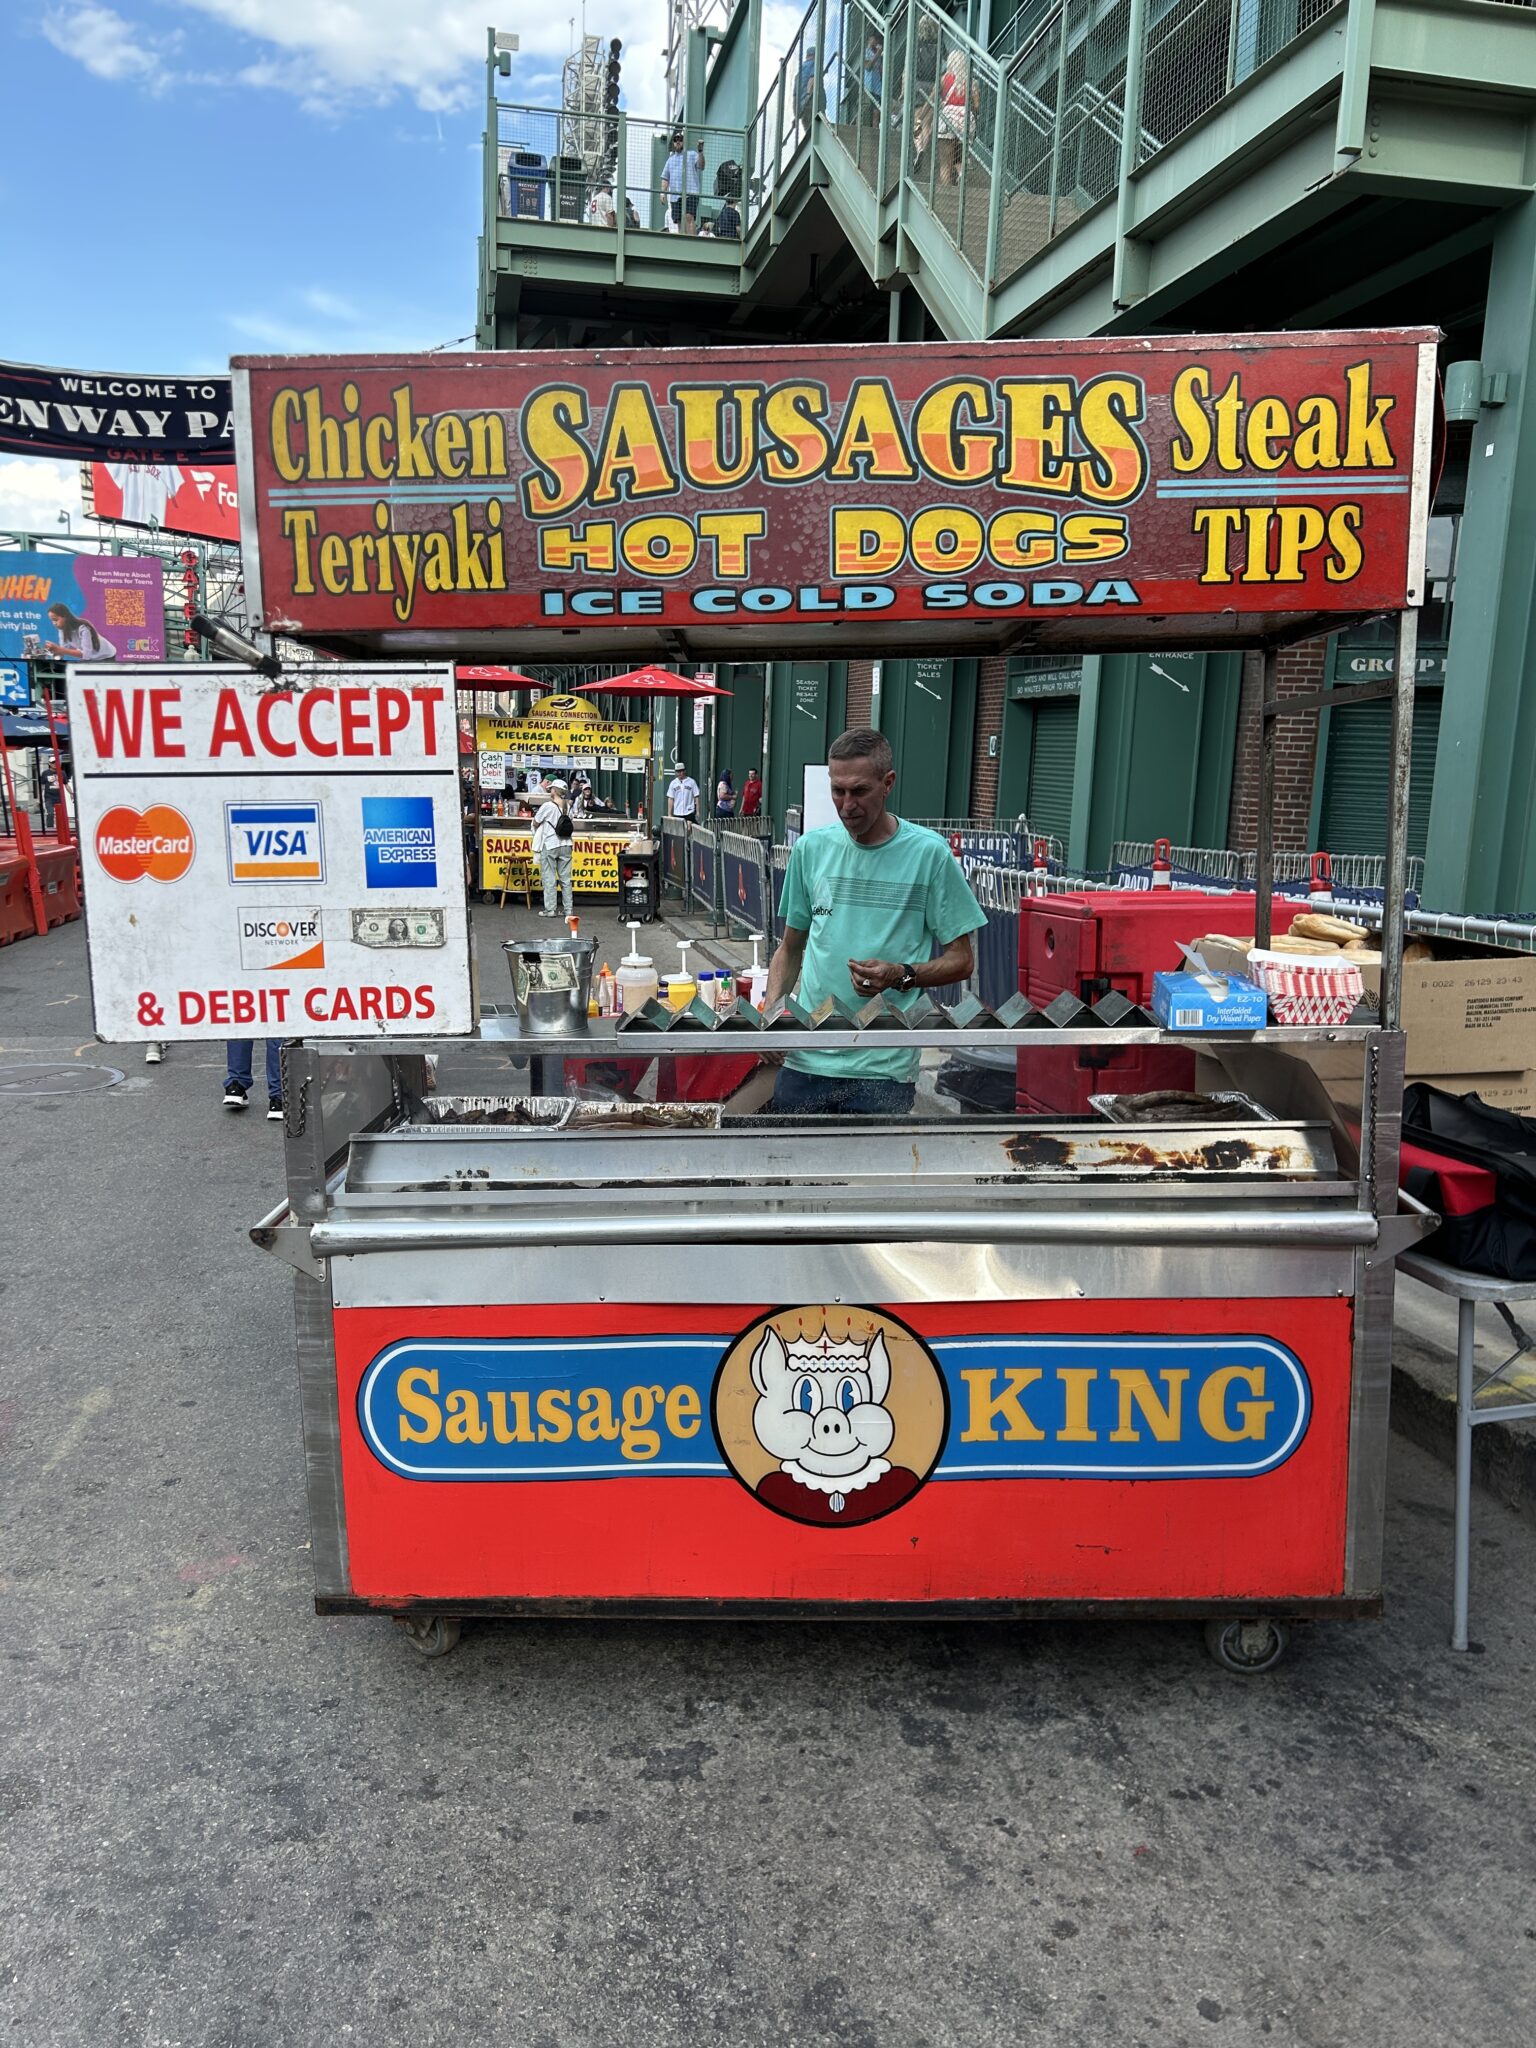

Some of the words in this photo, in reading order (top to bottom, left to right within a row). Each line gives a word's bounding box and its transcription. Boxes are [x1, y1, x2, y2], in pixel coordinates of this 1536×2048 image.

[60, 377, 177, 398] WELCOME
[186, 385, 216, 400] TO
[1170, 359, 1396, 475] Steak
[270, 381, 509, 483] Chicken
[523, 376, 1148, 516] SAUSAGES
[107, 448, 165, 461] GATE
[176, 449, 189, 461] E
[540, 509, 766, 579] HOT
[832, 504, 1129, 578] DOGS
[1192, 502, 1365, 585] TIPS
[282, 500, 509, 622] Teriyaki
[181, 551, 200, 620] GATE
[541, 588, 664, 617] ICE
[692, 582, 897, 614] COLD
[923, 578, 1141, 611] SODA
[13, 611, 23, 619] at
[25, 611, 41, 619] the
[22, 622, 37, 631] lab
[1351, 658, 1435, 672] GROP
[1025, 675, 1037, 683] GATES
[1048, 673, 1057, 681] WILL
[1024, 685, 1041, 693] MINUTES
[1042, 683, 1055, 691] PRIOR
[1064, 682, 1076, 690] FIRST
[531, 709, 558, 718] SAUSAGE
[560, 710, 598, 719] CONNECTION
[83, 688, 186, 759] WE
[209, 687, 444, 758] ACCEPT
[488, 719, 523, 729] ITALIAN
[527, 721, 571, 731] SAUSAGE
[584, 723, 614, 733] STEAK
[618, 724, 640, 733] TIPS
[496, 731, 553, 741] KIELBASA
[570, 733, 594, 743] HOT
[600, 735, 633, 744] DOGS
[509, 742, 560, 753] CHICKEN
[566, 744, 620, 755] TERIYAKI
[481, 752, 502, 762] Cash
[481, 761, 502, 770] Credit
[481, 768, 502, 777] Debit
[244, 829, 307, 857] VISA
[364, 829, 431, 843] AMERICAN
[99, 835, 190, 856] MasterCard
[486, 839, 532, 853] SAUSA
[574, 841, 630, 855] NNECTI
[379, 848, 437, 862] EXPRESS
[583, 858, 613, 866] STEAK
[499, 867, 540, 876] KELBA
[572, 869, 595, 877] HOT
[244, 922, 317, 937] DISCOVER
[1432, 980, 1455, 988] 0022
[1464, 978, 1492, 987] 26129
[137, 991, 165, 1027] &
[178, 989, 290, 1025] DEBIT
[304, 984, 435, 1022] CARDS
[1217, 1006, 1252, 1015] Interfolded
[1207, 1015, 1219, 1024] Dry
[1243, 1015, 1262, 1024] Paper
[397, 1366, 702, 1460] Sausage
[960, 1364, 1276, 1444] KING
